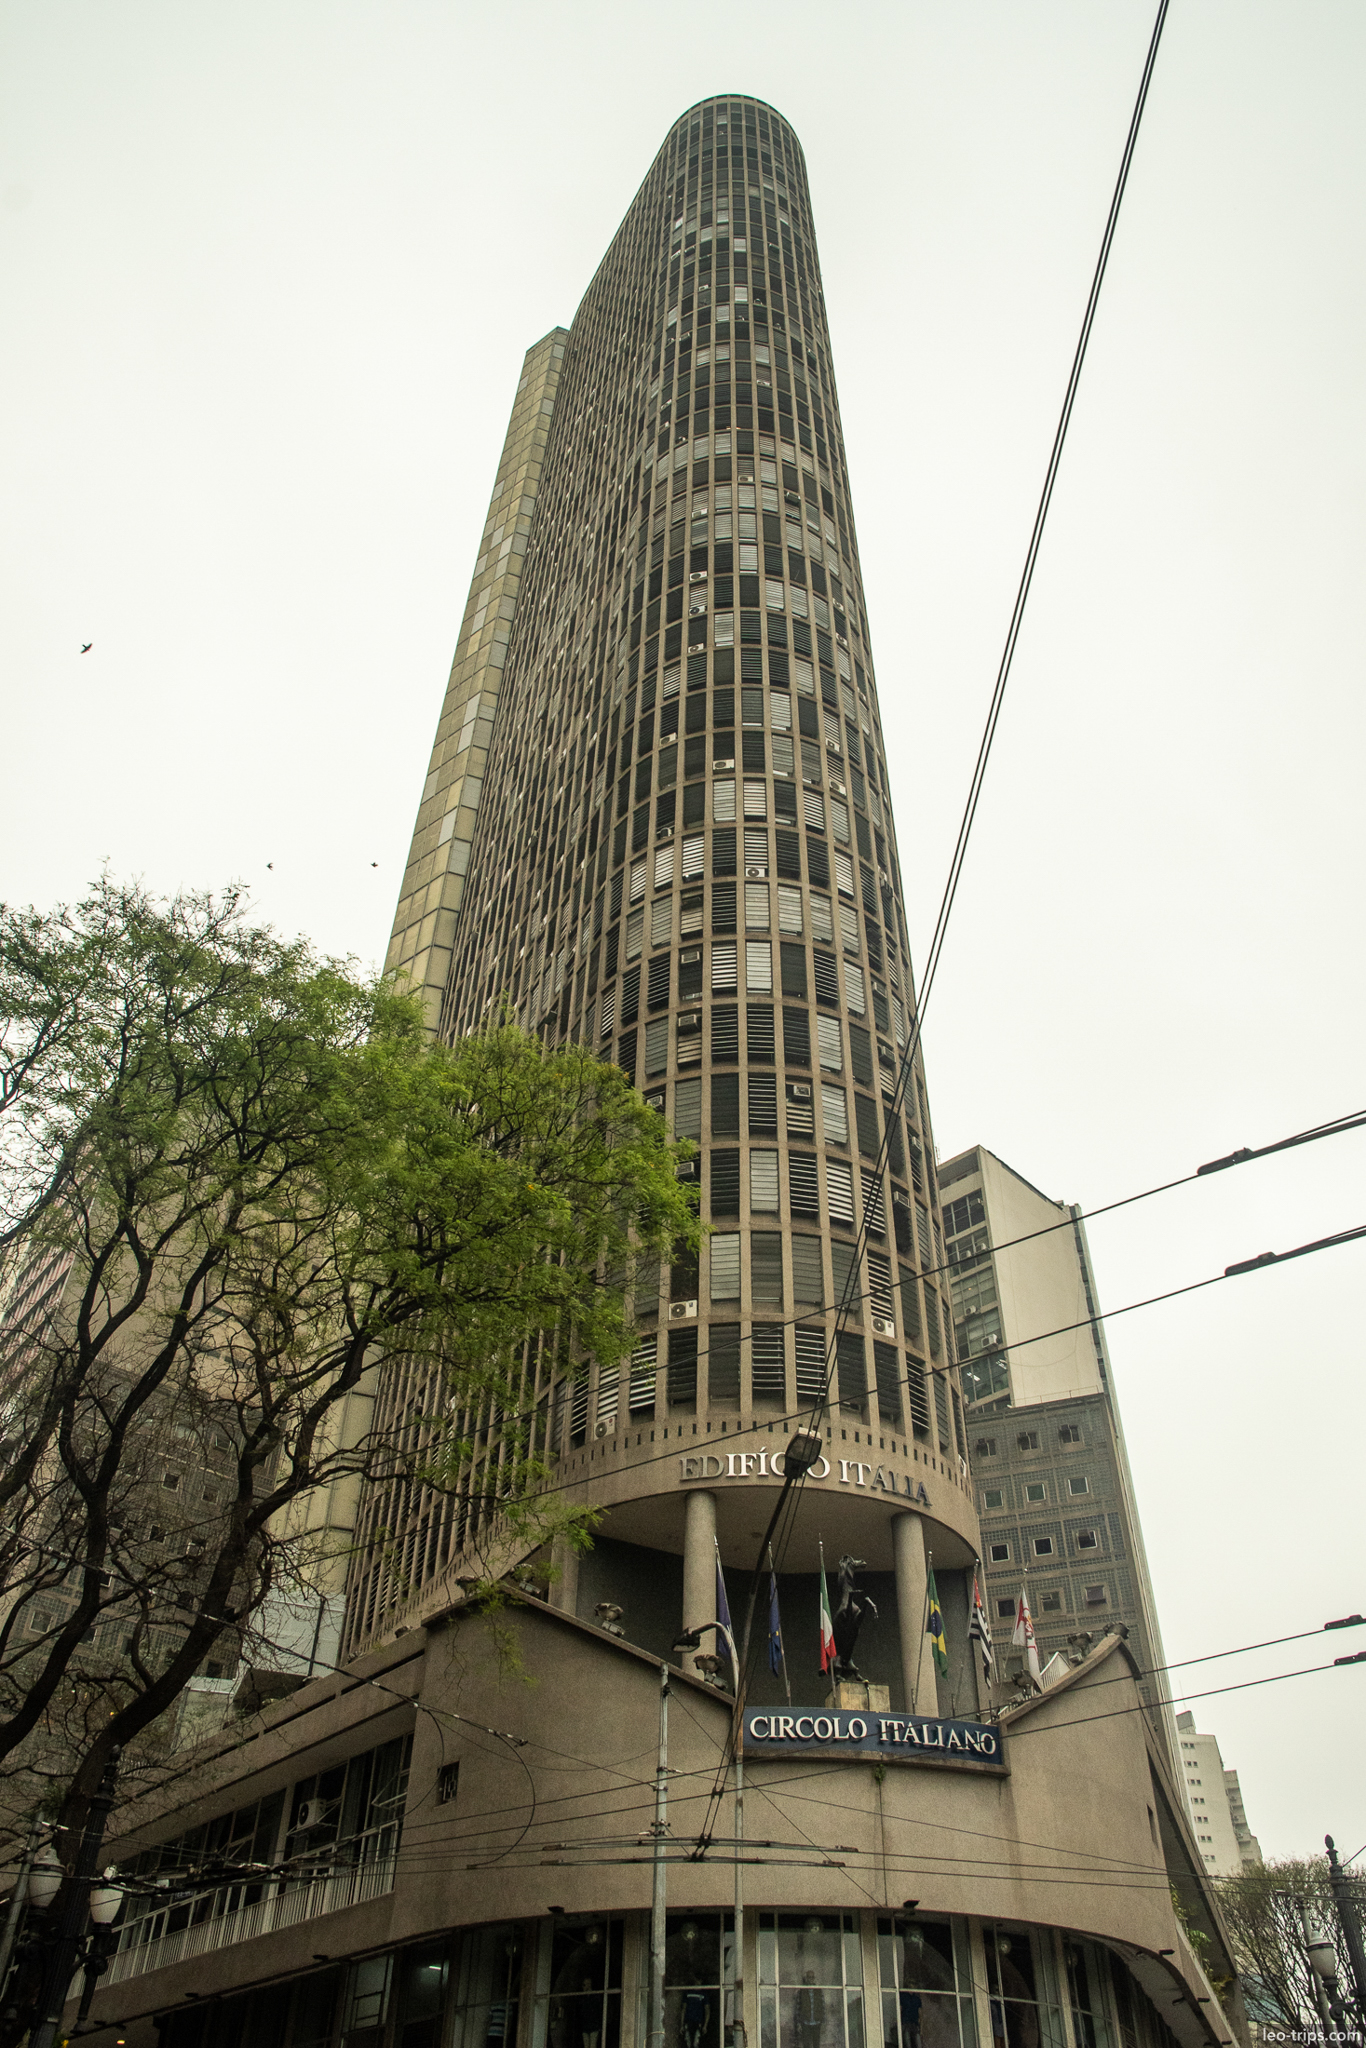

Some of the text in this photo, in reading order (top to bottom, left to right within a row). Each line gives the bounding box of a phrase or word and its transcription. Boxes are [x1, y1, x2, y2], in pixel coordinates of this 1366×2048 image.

[680, 1446, 831, 1481] EDIFÍCO
[750, 1716, 997, 1755] CIRCOLO ITALIANO
